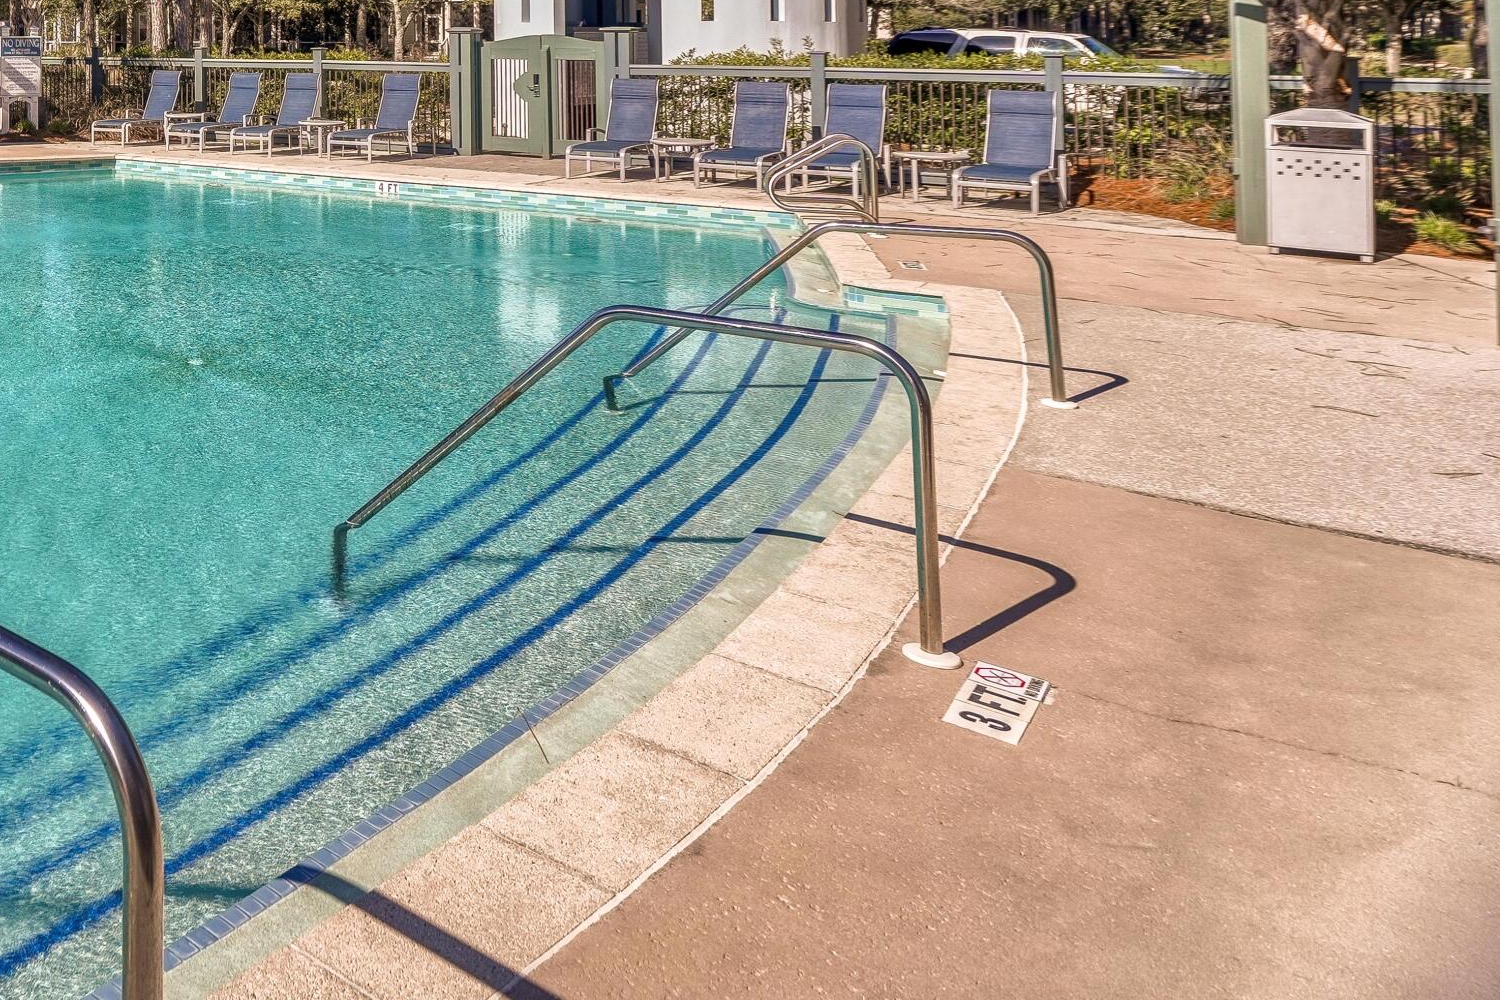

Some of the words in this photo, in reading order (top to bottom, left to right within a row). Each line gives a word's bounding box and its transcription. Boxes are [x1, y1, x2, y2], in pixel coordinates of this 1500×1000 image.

[2, 39, 13, 48] NO
[16, 39, 40, 48] DIVING
[378, 182, 384, 192] 4
[958, 710, 1012, 732] 3
